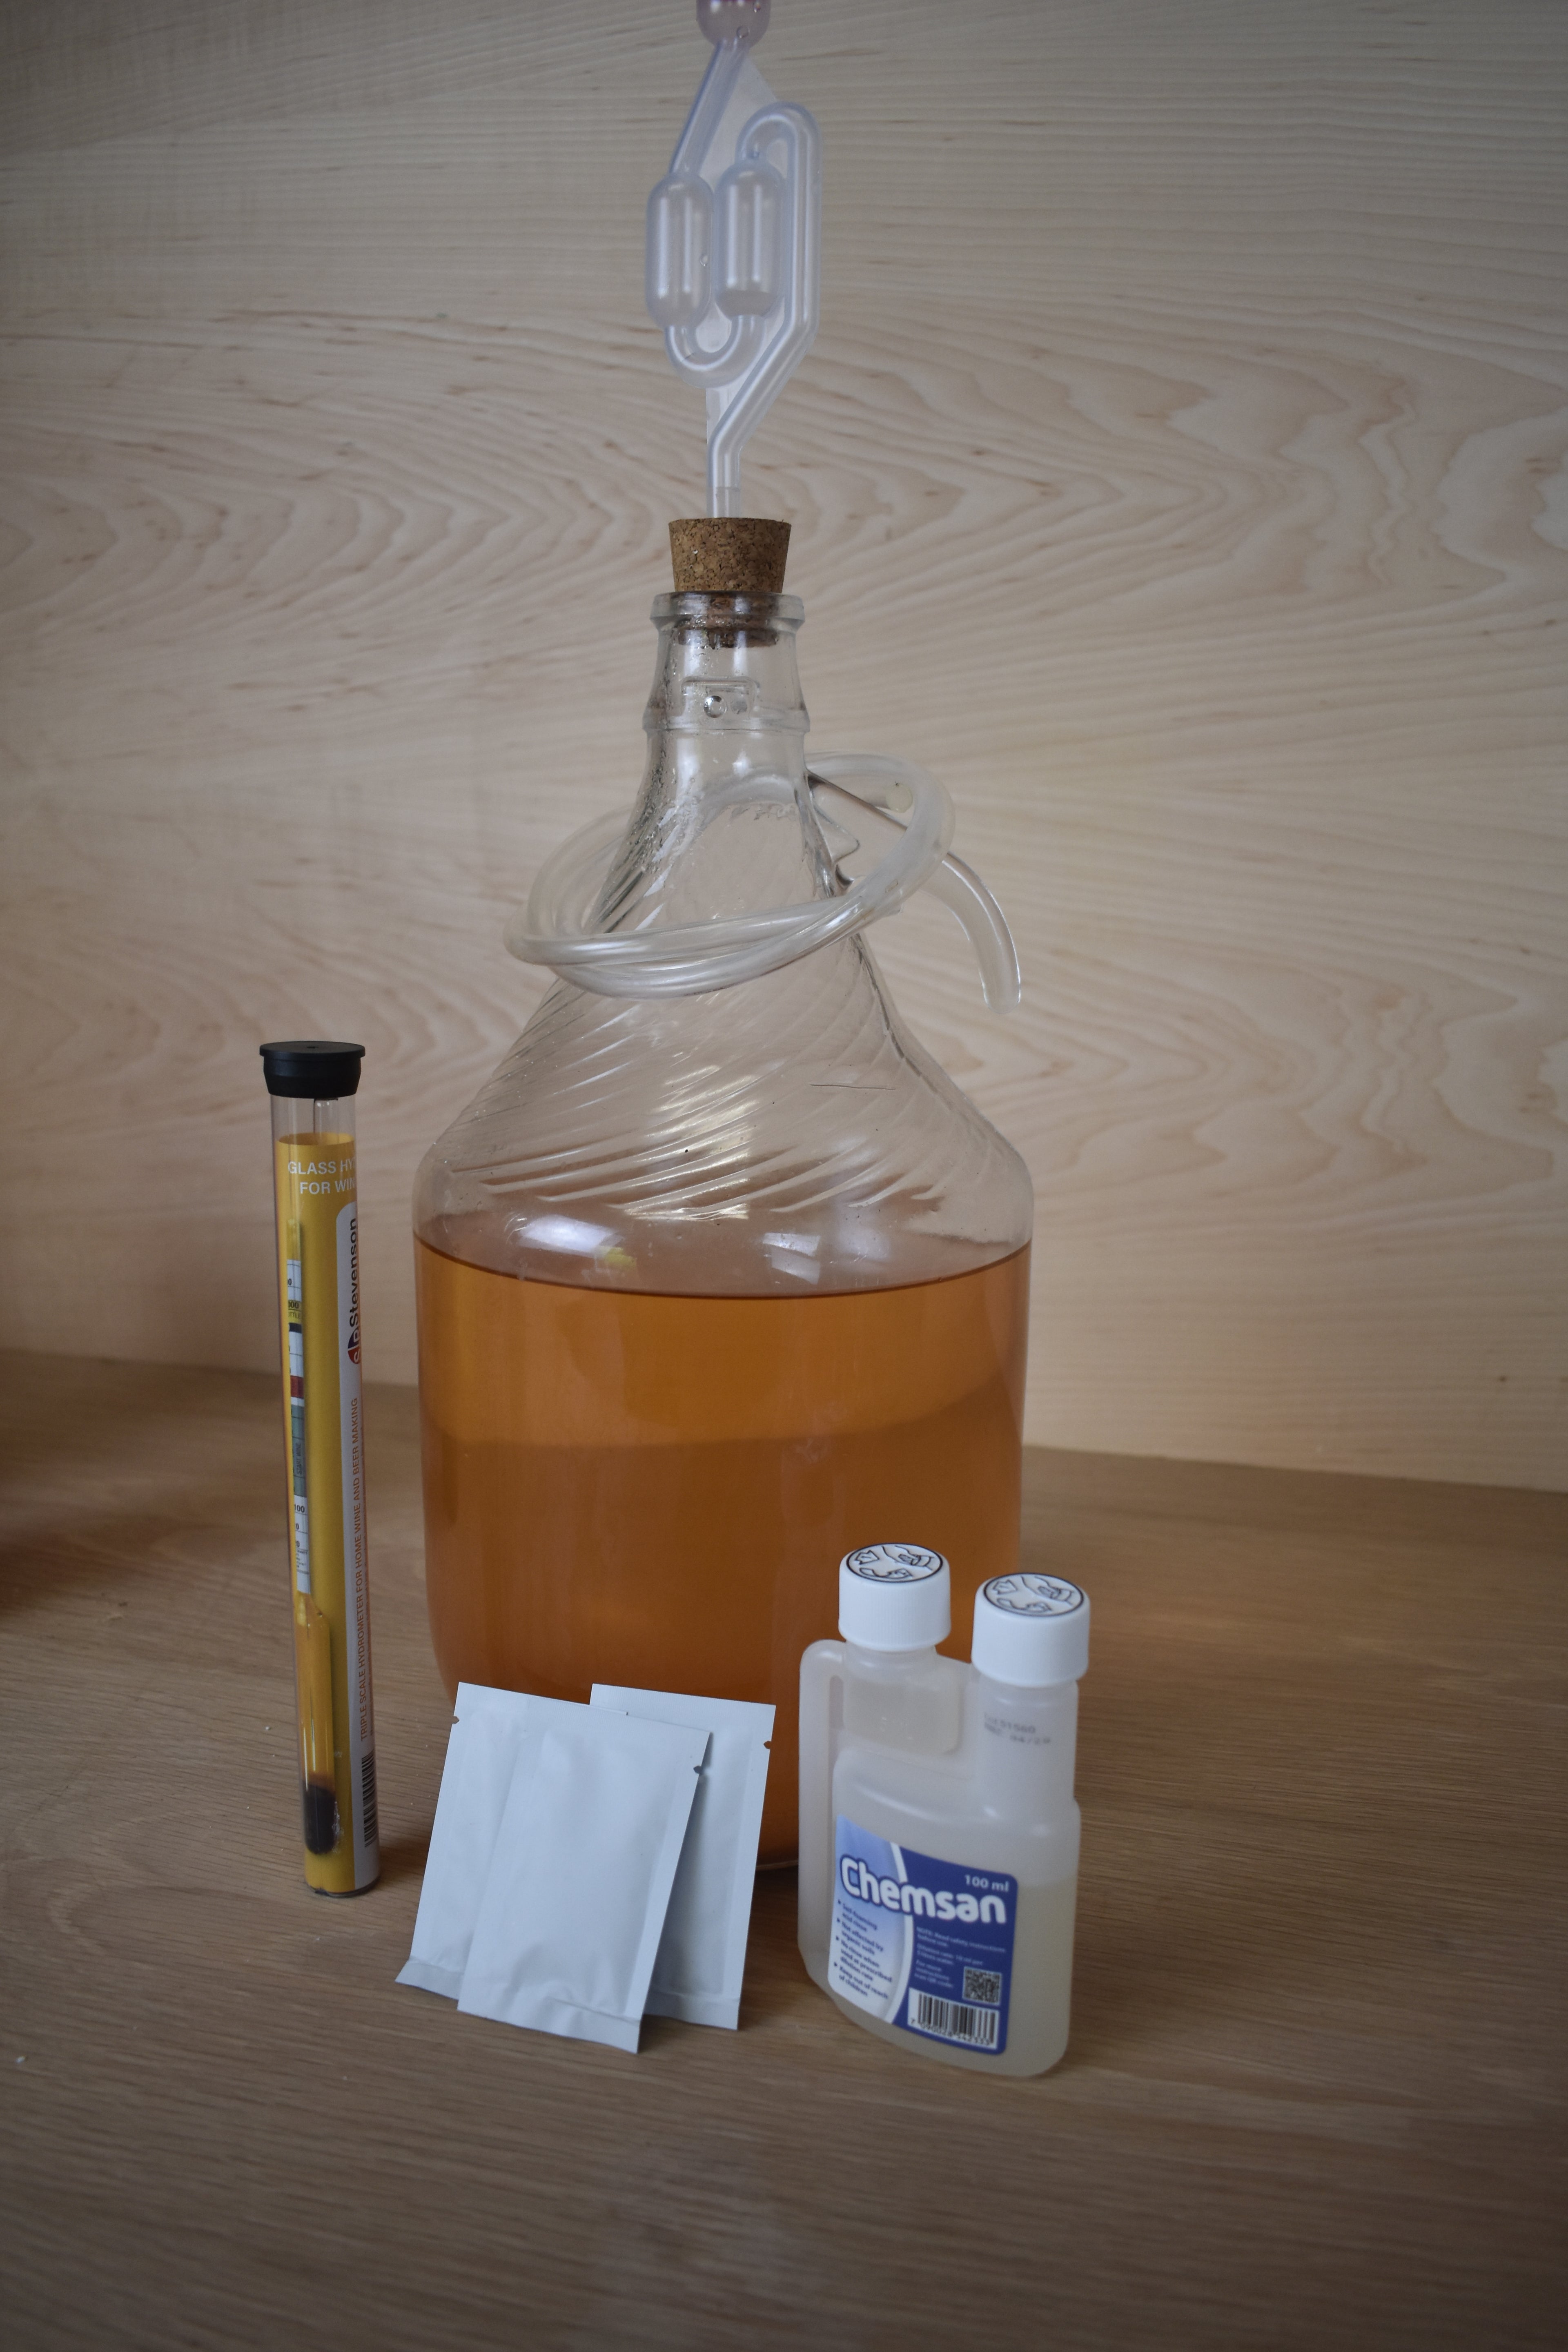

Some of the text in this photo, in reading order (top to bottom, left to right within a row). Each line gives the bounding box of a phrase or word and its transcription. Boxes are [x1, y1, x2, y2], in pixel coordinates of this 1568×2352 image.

[288, 1160, 336, 1174] GLASS
[300, 1181, 330, 1194] FOR
[350, 1218, 359, 1327] Stevenson
[356, 1594, 365, 1668] HYDROMETER
[840, 1855, 1007, 1924] Chemsan
[965, 1874, 1009, 1892] 100 ml
